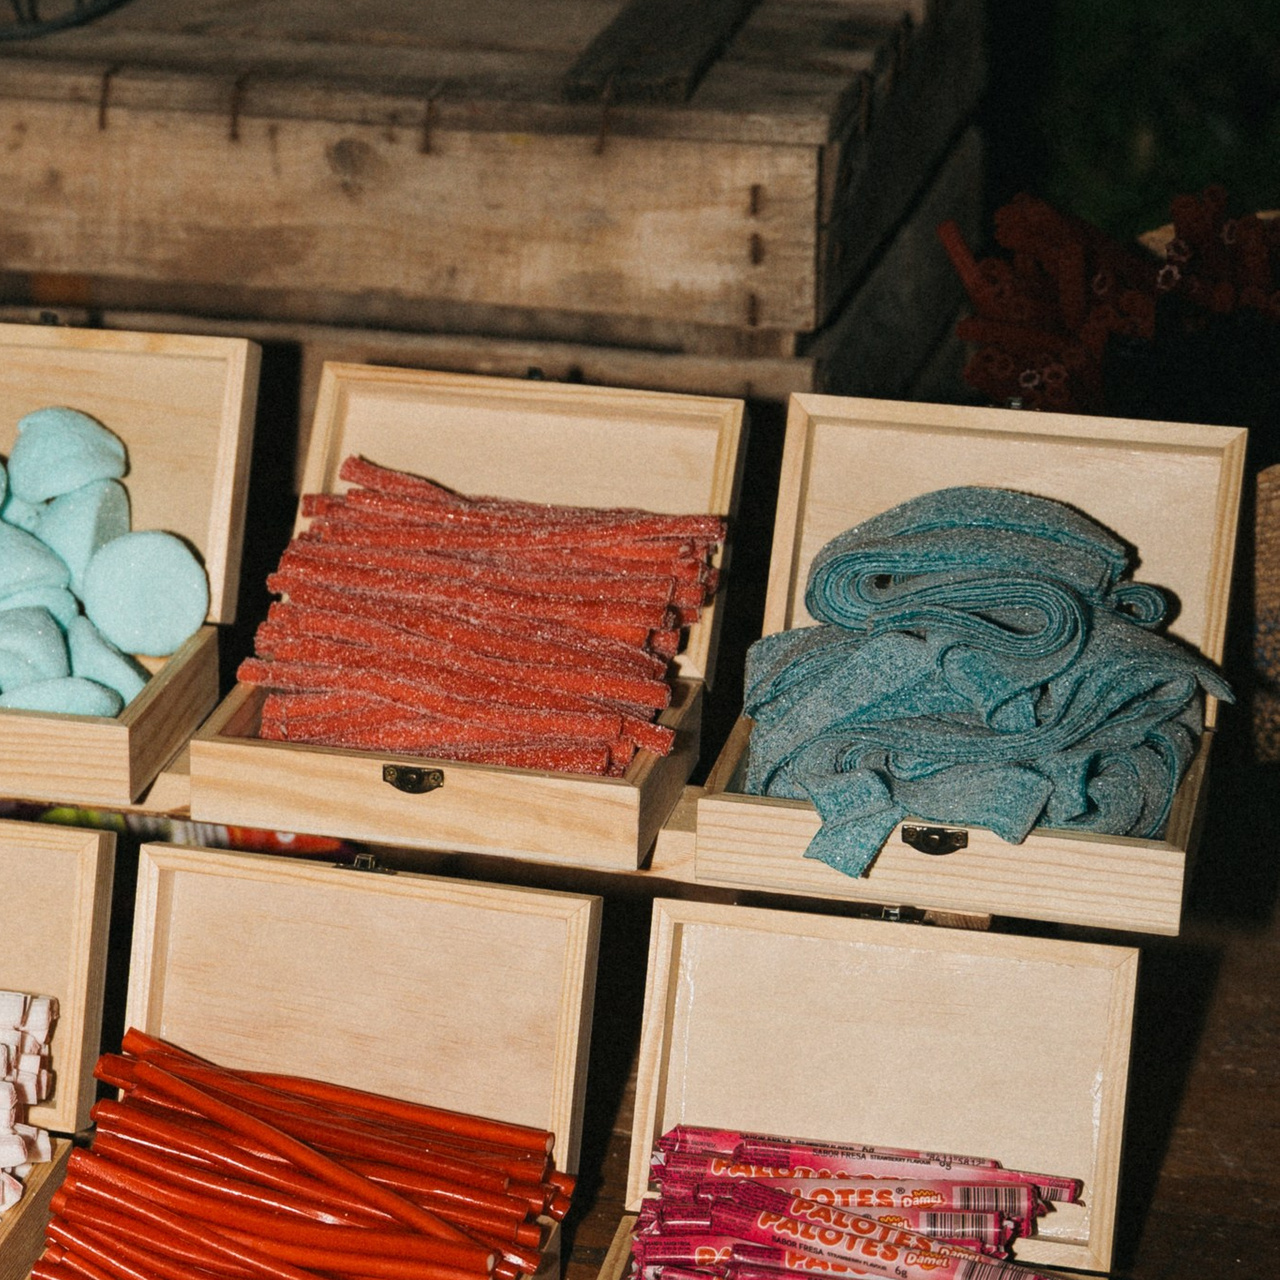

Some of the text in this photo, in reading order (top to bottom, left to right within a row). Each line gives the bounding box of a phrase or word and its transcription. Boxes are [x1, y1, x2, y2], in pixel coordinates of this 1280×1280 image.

[812, 1148, 839, 1157] SABOR
[841, 1151, 866, 1160] FRESA
[759, 1211, 899, 1261] PALOTES
[791, 1198, 932, 1250] PALOTES
[772, 1236, 798, 1248] SABOR
[799, 1242, 824, 1256] FRESA
[894, 1266, 908, 1278] 6g
